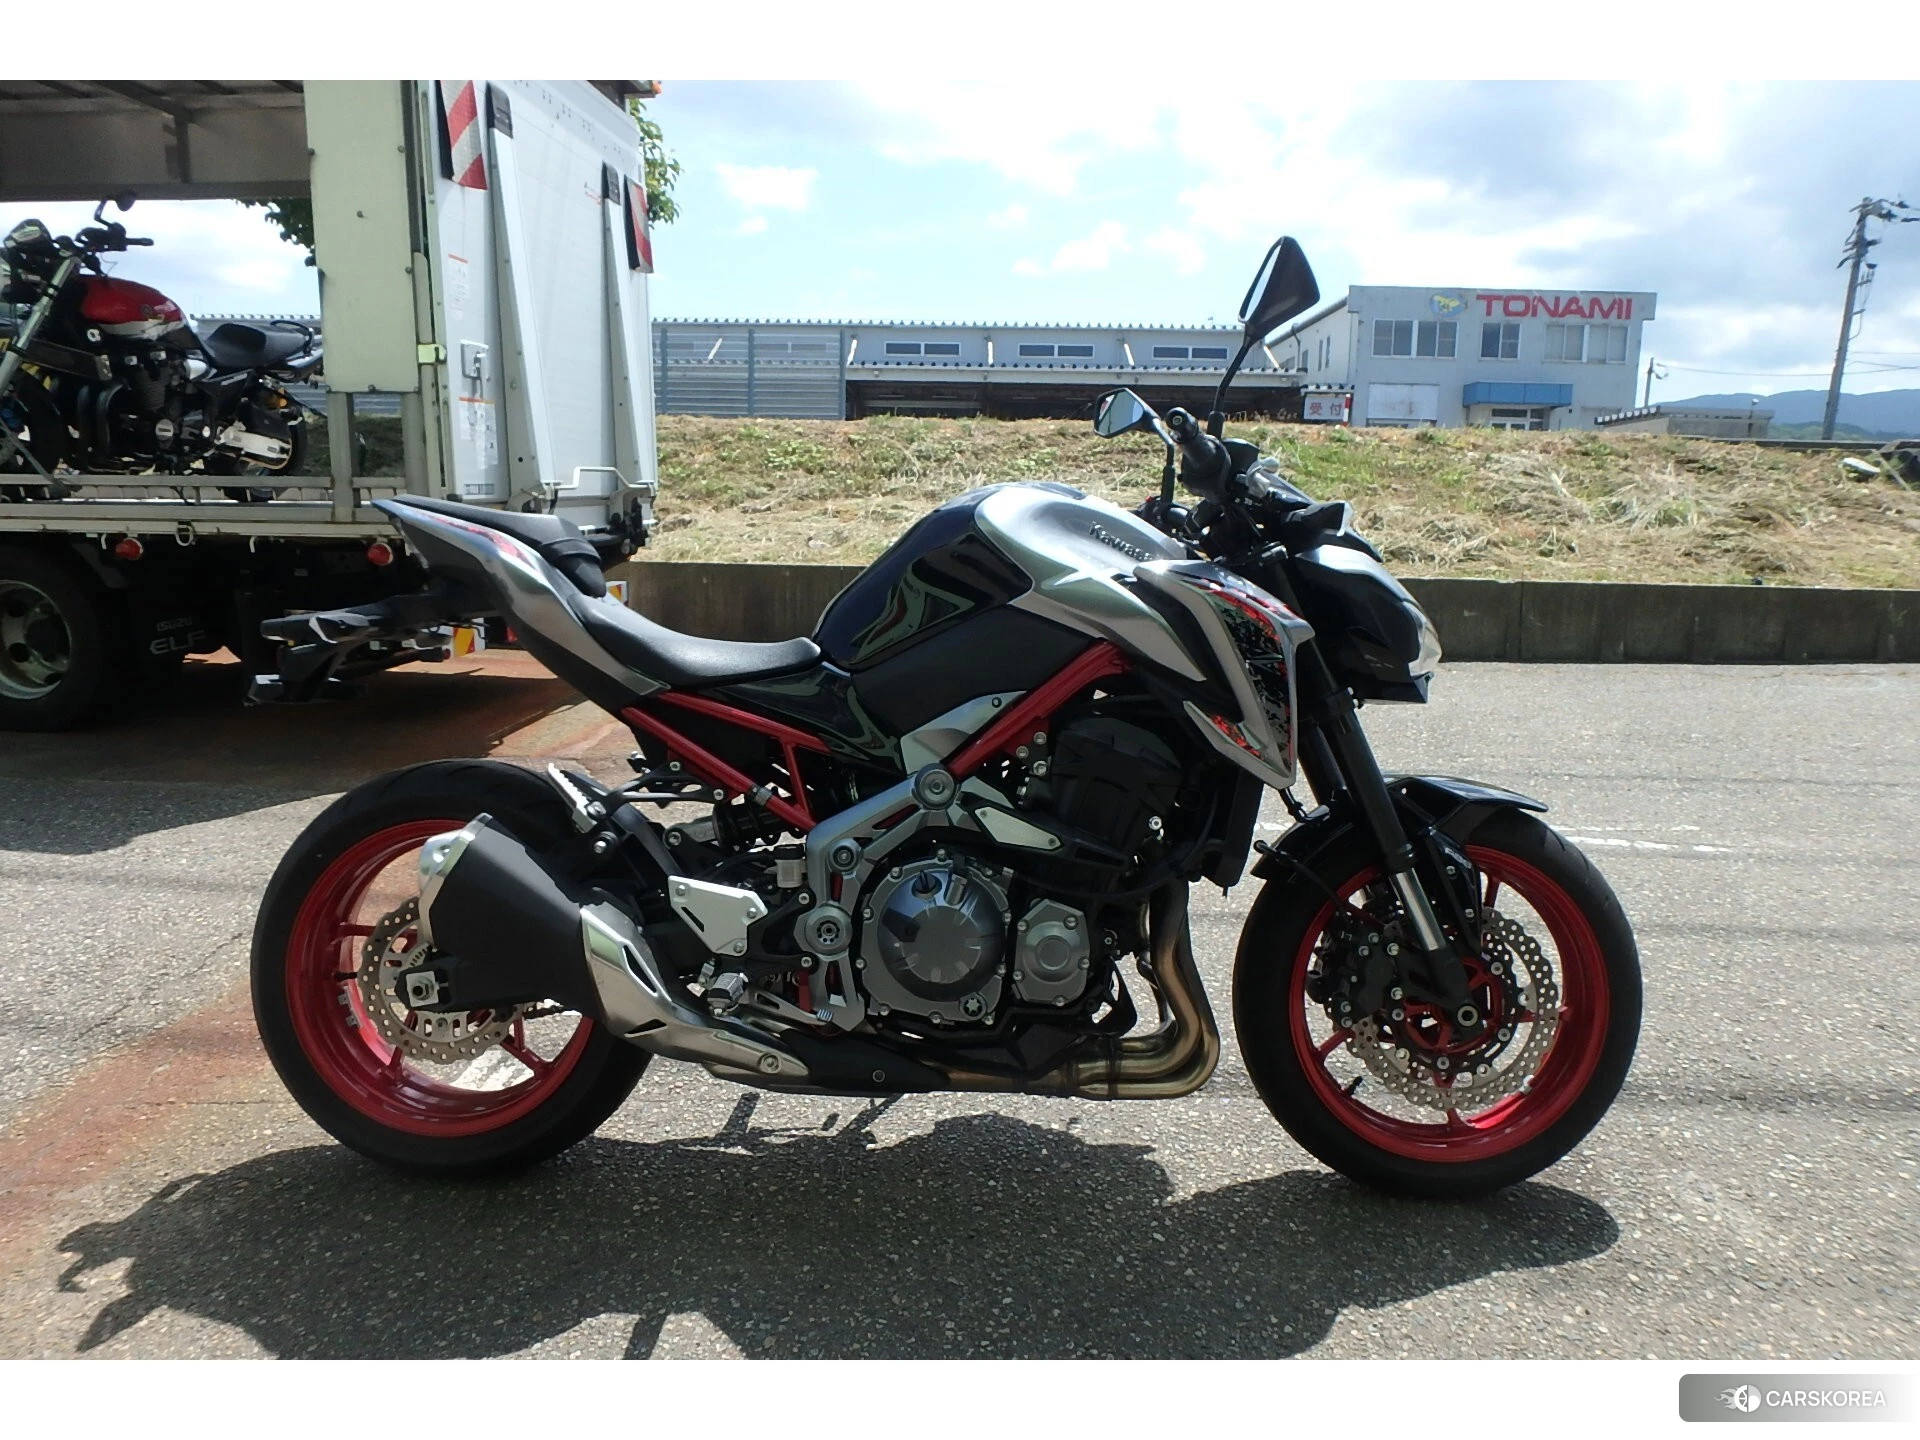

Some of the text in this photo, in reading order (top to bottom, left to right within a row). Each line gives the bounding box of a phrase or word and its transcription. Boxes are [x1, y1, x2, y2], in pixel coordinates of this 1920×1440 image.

[1476, 294, 1632, 320] TONAMI
[156, 616, 192, 632] ISUZU
[150, 630, 206, 654] ELF
